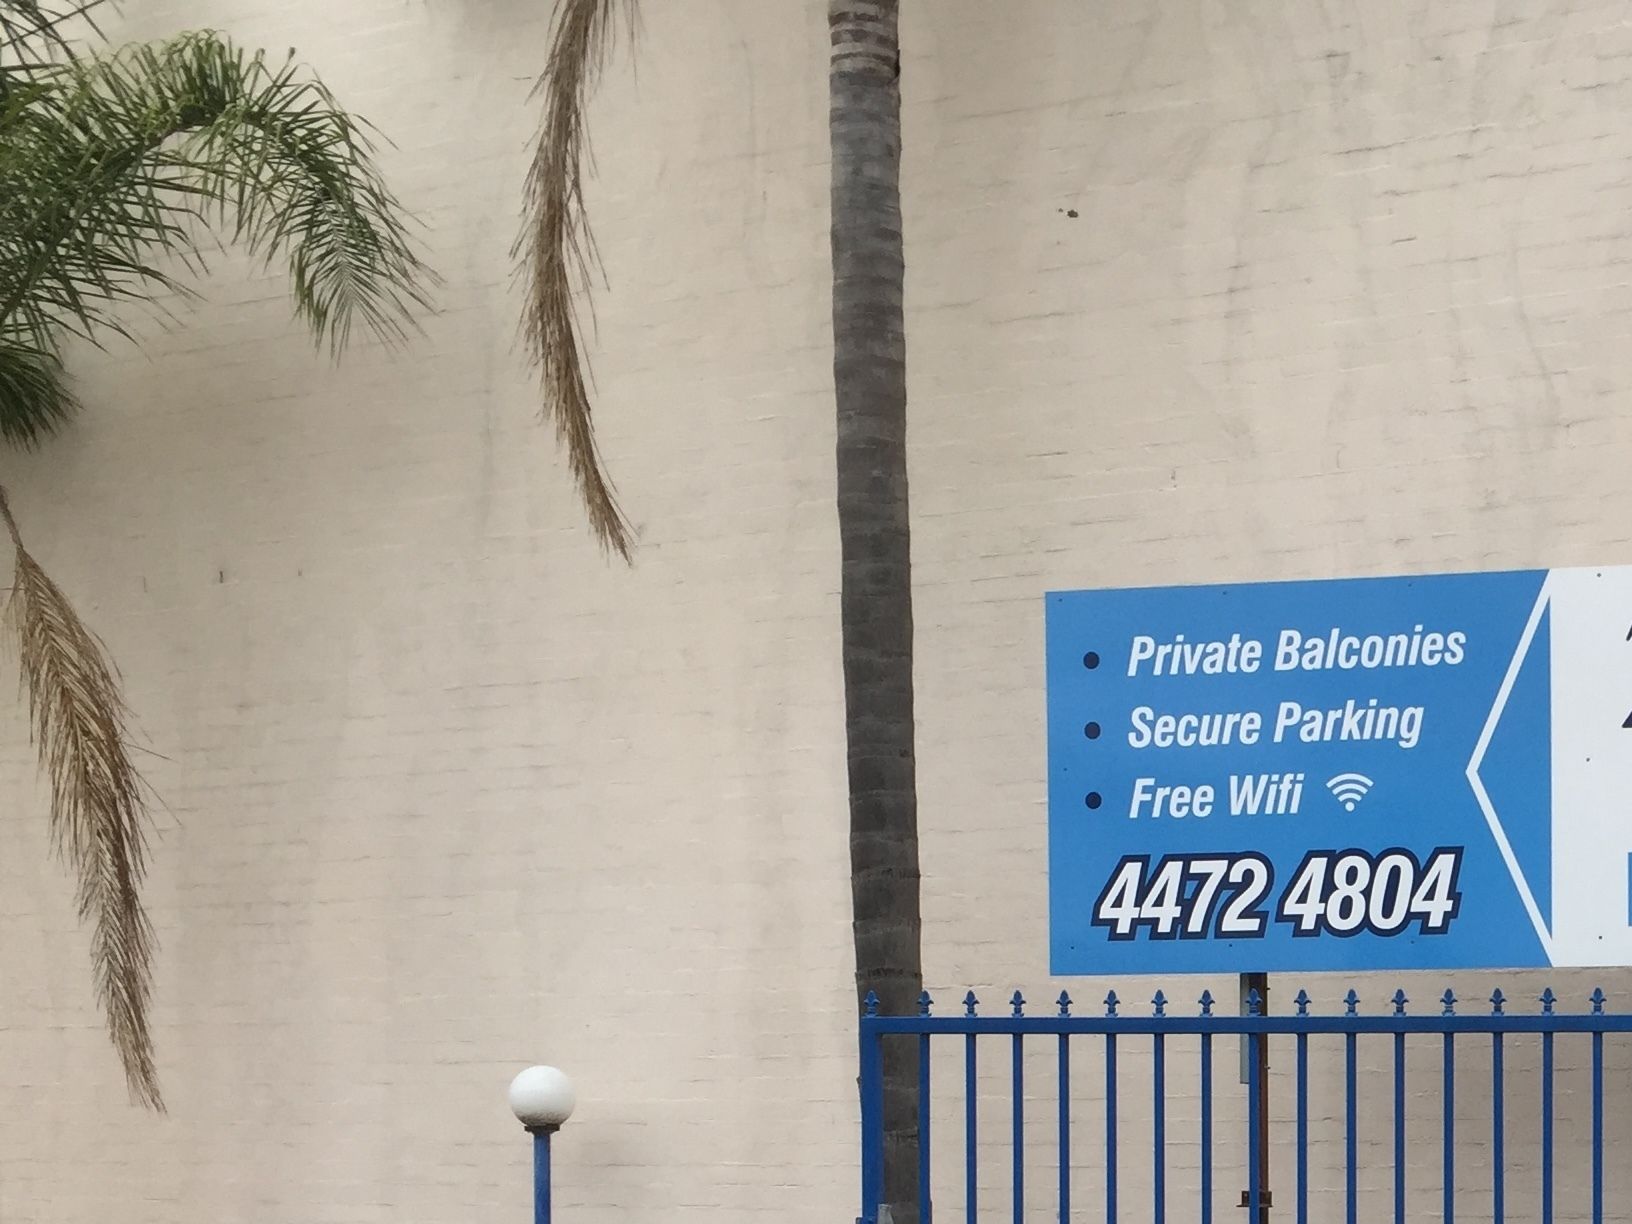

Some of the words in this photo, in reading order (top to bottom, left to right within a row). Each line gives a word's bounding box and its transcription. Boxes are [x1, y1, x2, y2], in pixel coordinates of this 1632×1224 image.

[1127, 633, 1262, 677] Private
[1274, 625, 1466, 672] Balconies
[1127, 706, 1261, 749] Secure
[1273, 698, 1424, 749] Parking
[1128, 777, 1215, 819] Free
[1229, 772, 1305, 816] Wifi
[1091, 852, 1274, 941] 4472
[1275, 846, 1464, 937] 4804
